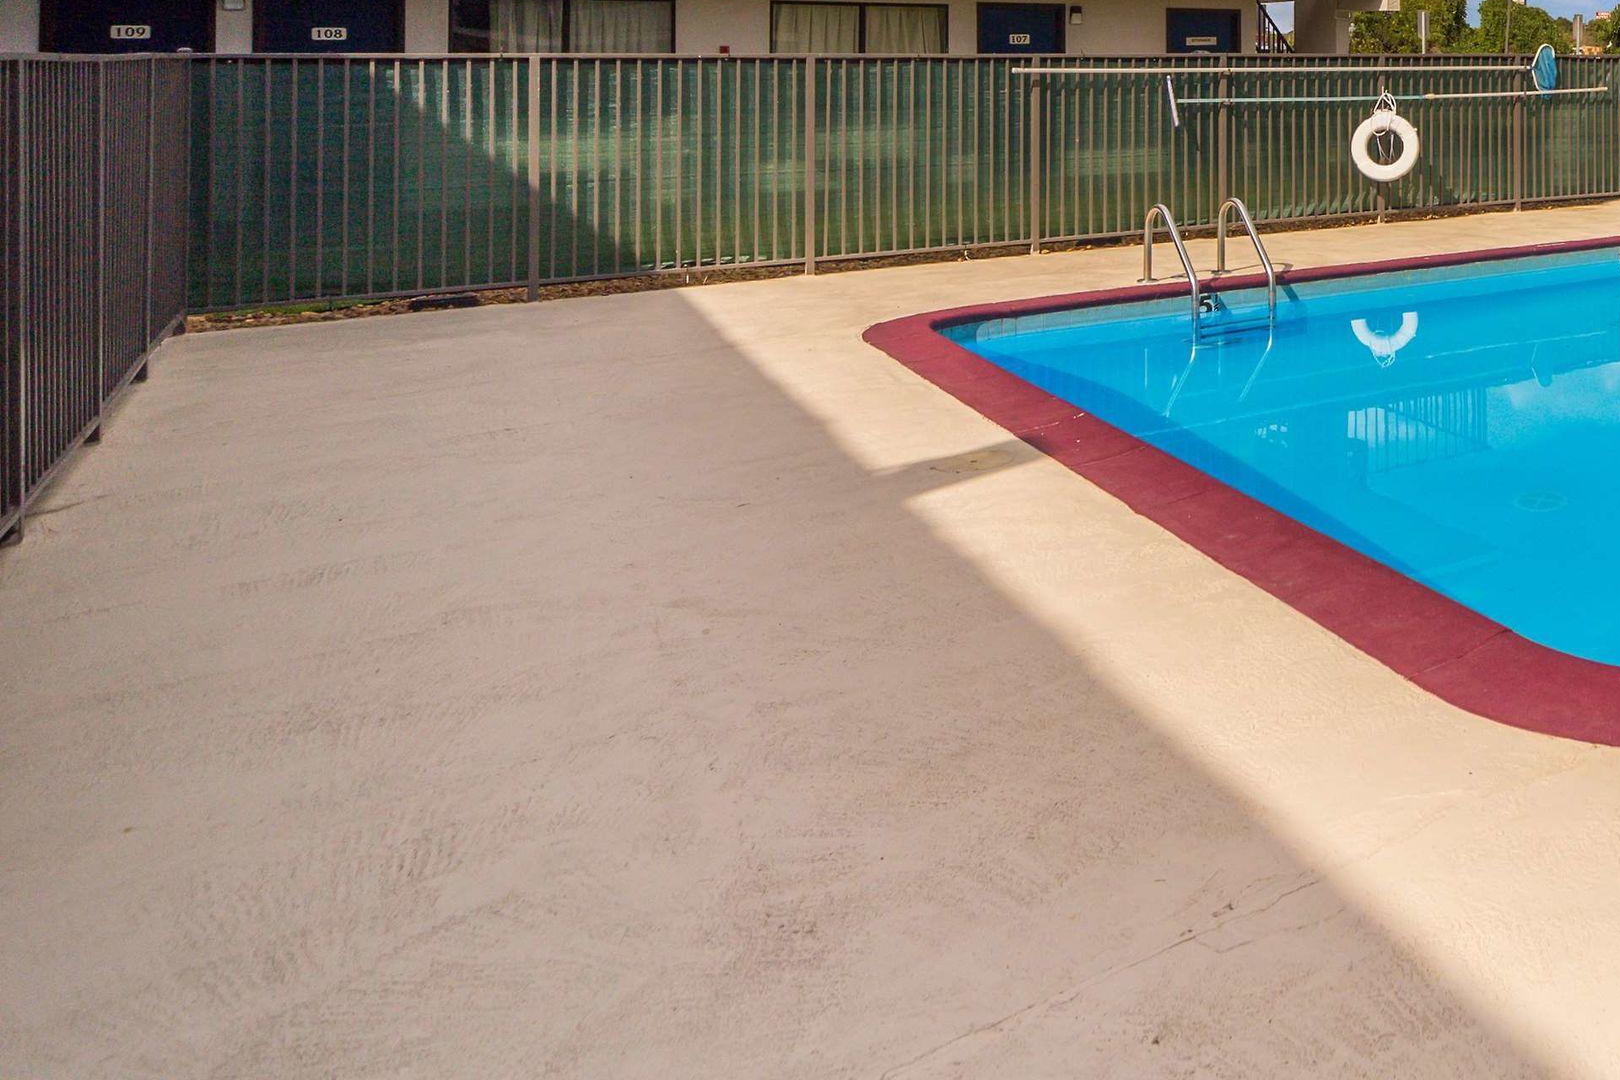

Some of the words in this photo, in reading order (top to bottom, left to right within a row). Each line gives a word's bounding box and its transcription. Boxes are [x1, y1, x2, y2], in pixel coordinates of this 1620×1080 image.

[116, 26, 146, 37] 109
[316, 28, 343, 39] 108
[1011, 35, 1028, 43] 107
